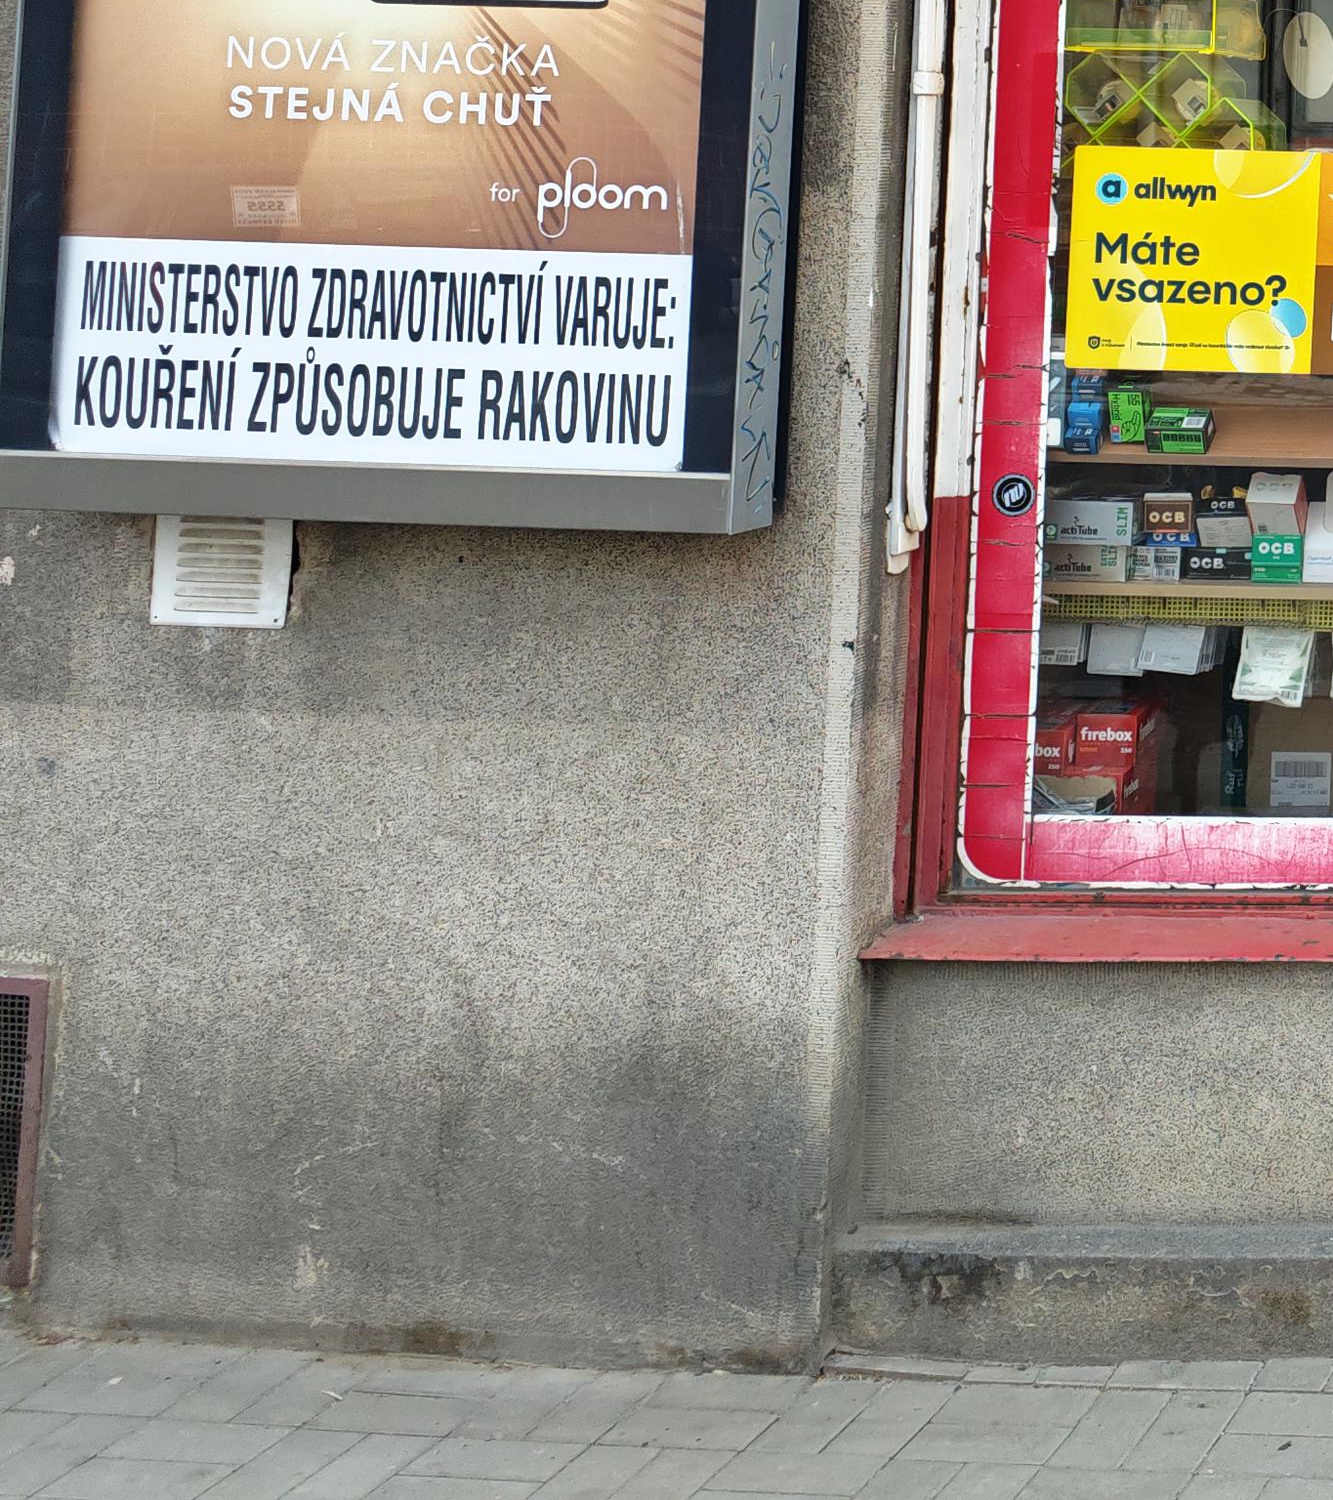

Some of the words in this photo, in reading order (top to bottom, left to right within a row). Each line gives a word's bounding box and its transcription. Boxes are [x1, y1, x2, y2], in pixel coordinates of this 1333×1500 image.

[227, 35, 348, 73] NOVÁ
[371, 34, 559, 78] ZNAČKA
[229, 85, 405, 124] STEJNÁ
[422, 89, 552, 128] CHUŤ
[489, 182, 521, 203] for
[537, 157, 668, 239] ploom
[1102, 180, 1121, 198] a
[1134, 177, 1216, 207] allwyn
[1095, 232, 1200, 266] Máte
[79, 260, 297, 338] MINISTERSTVO
[307, 261, 550, 344] ZDRAVOTNICTVÍ
[556, 276, 676, 350] VARUJE:
[1092, 275, 1286, 307] vsazeno?
[74, 345, 241, 432] KOUŘENÍ
[247, 346, 464, 440] ZPŮSOBUJE
[479, 371, 671, 446] RAKOVINU
[1149, 511, 1185, 523] OCB
[1210, 501, 1235, 509] OCB
[1117, 507, 1128, 537] SLIM
[1153, 532, 1189, 542] OCB
[1190, 557, 1224, 569] OCB
[1258, 542, 1294, 554] OCB
[1081, 726, 1132, 742] firebox
[1034, 744, 1060, 757] box
